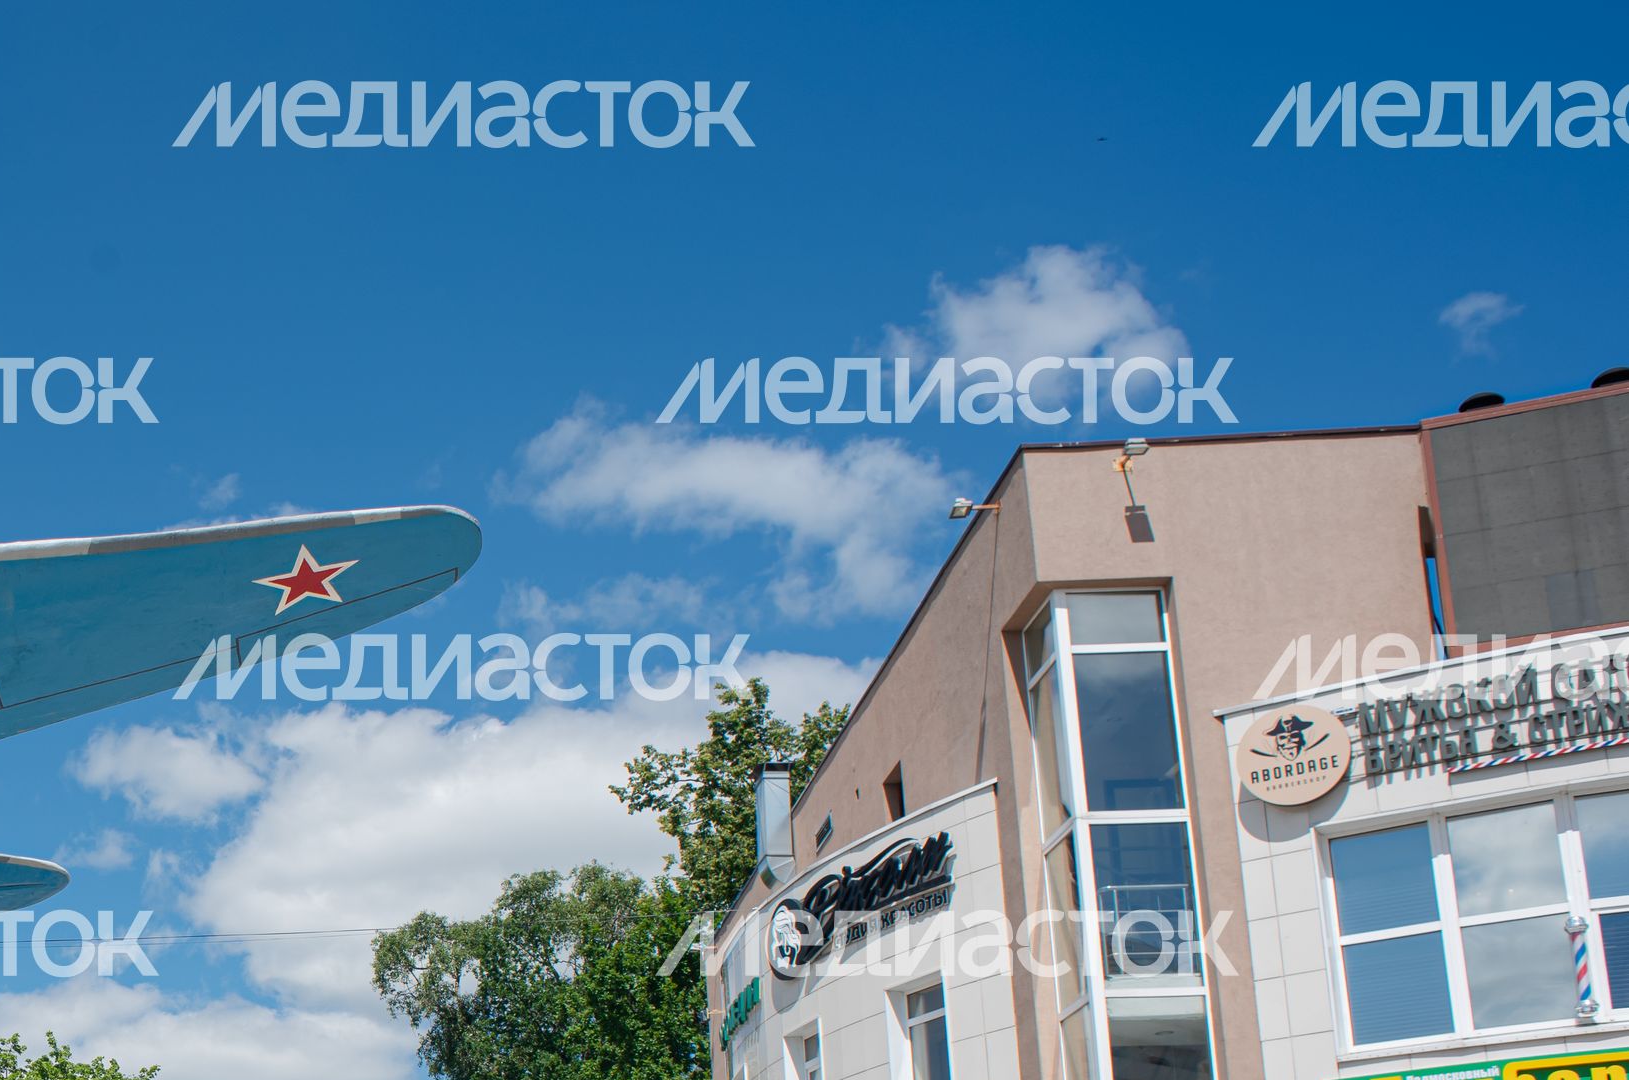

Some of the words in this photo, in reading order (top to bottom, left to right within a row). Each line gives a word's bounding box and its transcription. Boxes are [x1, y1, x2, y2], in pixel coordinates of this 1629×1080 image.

[1364, 726, 1476, 774] БРИТЬЯ
[1492, 721, 1516, 749] &
[1250, 754, 1339, 784] ABORDAGE
[881, 888, 949, 930] КРАСОТЫ
